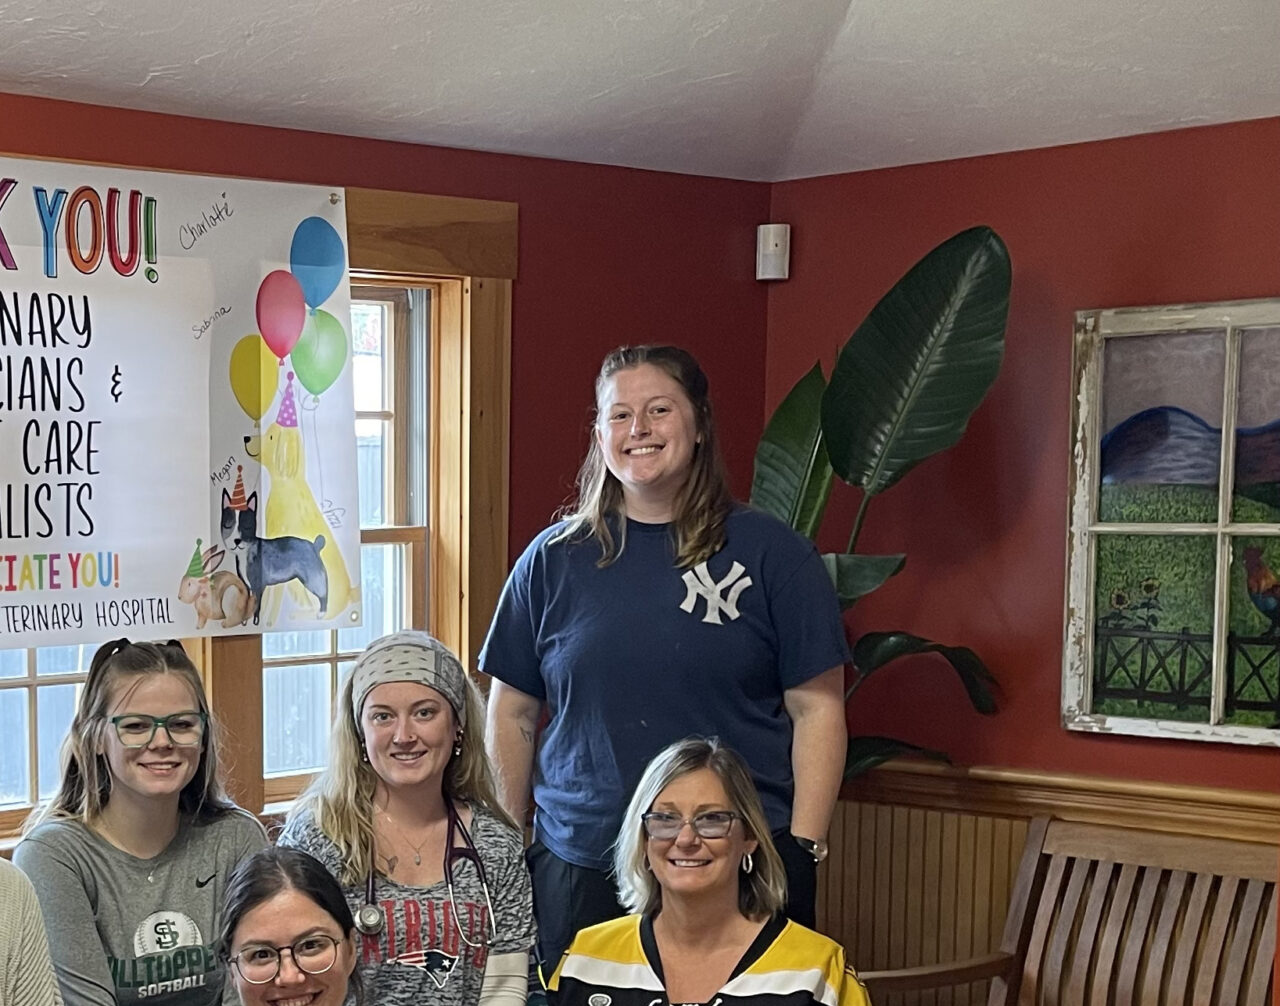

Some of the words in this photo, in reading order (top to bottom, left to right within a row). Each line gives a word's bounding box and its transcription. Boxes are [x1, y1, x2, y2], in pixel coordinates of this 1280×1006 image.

[32, 185, 158, 283] YOU!
[179, 201, 234, 250] Charlotte
[192, 306, 232, 340] Sabrina
[111, 365, 123, 403] &
[23, 419, 101, 475] CARE
[210, 455, 236, 487] Megan
[67, 552, 120, 589] YOU!
[679, 560, 753, 625] NY
[95, 597, 174, 627] HOSPITAL
[138, 974, 206, 998] SOFTBALL
